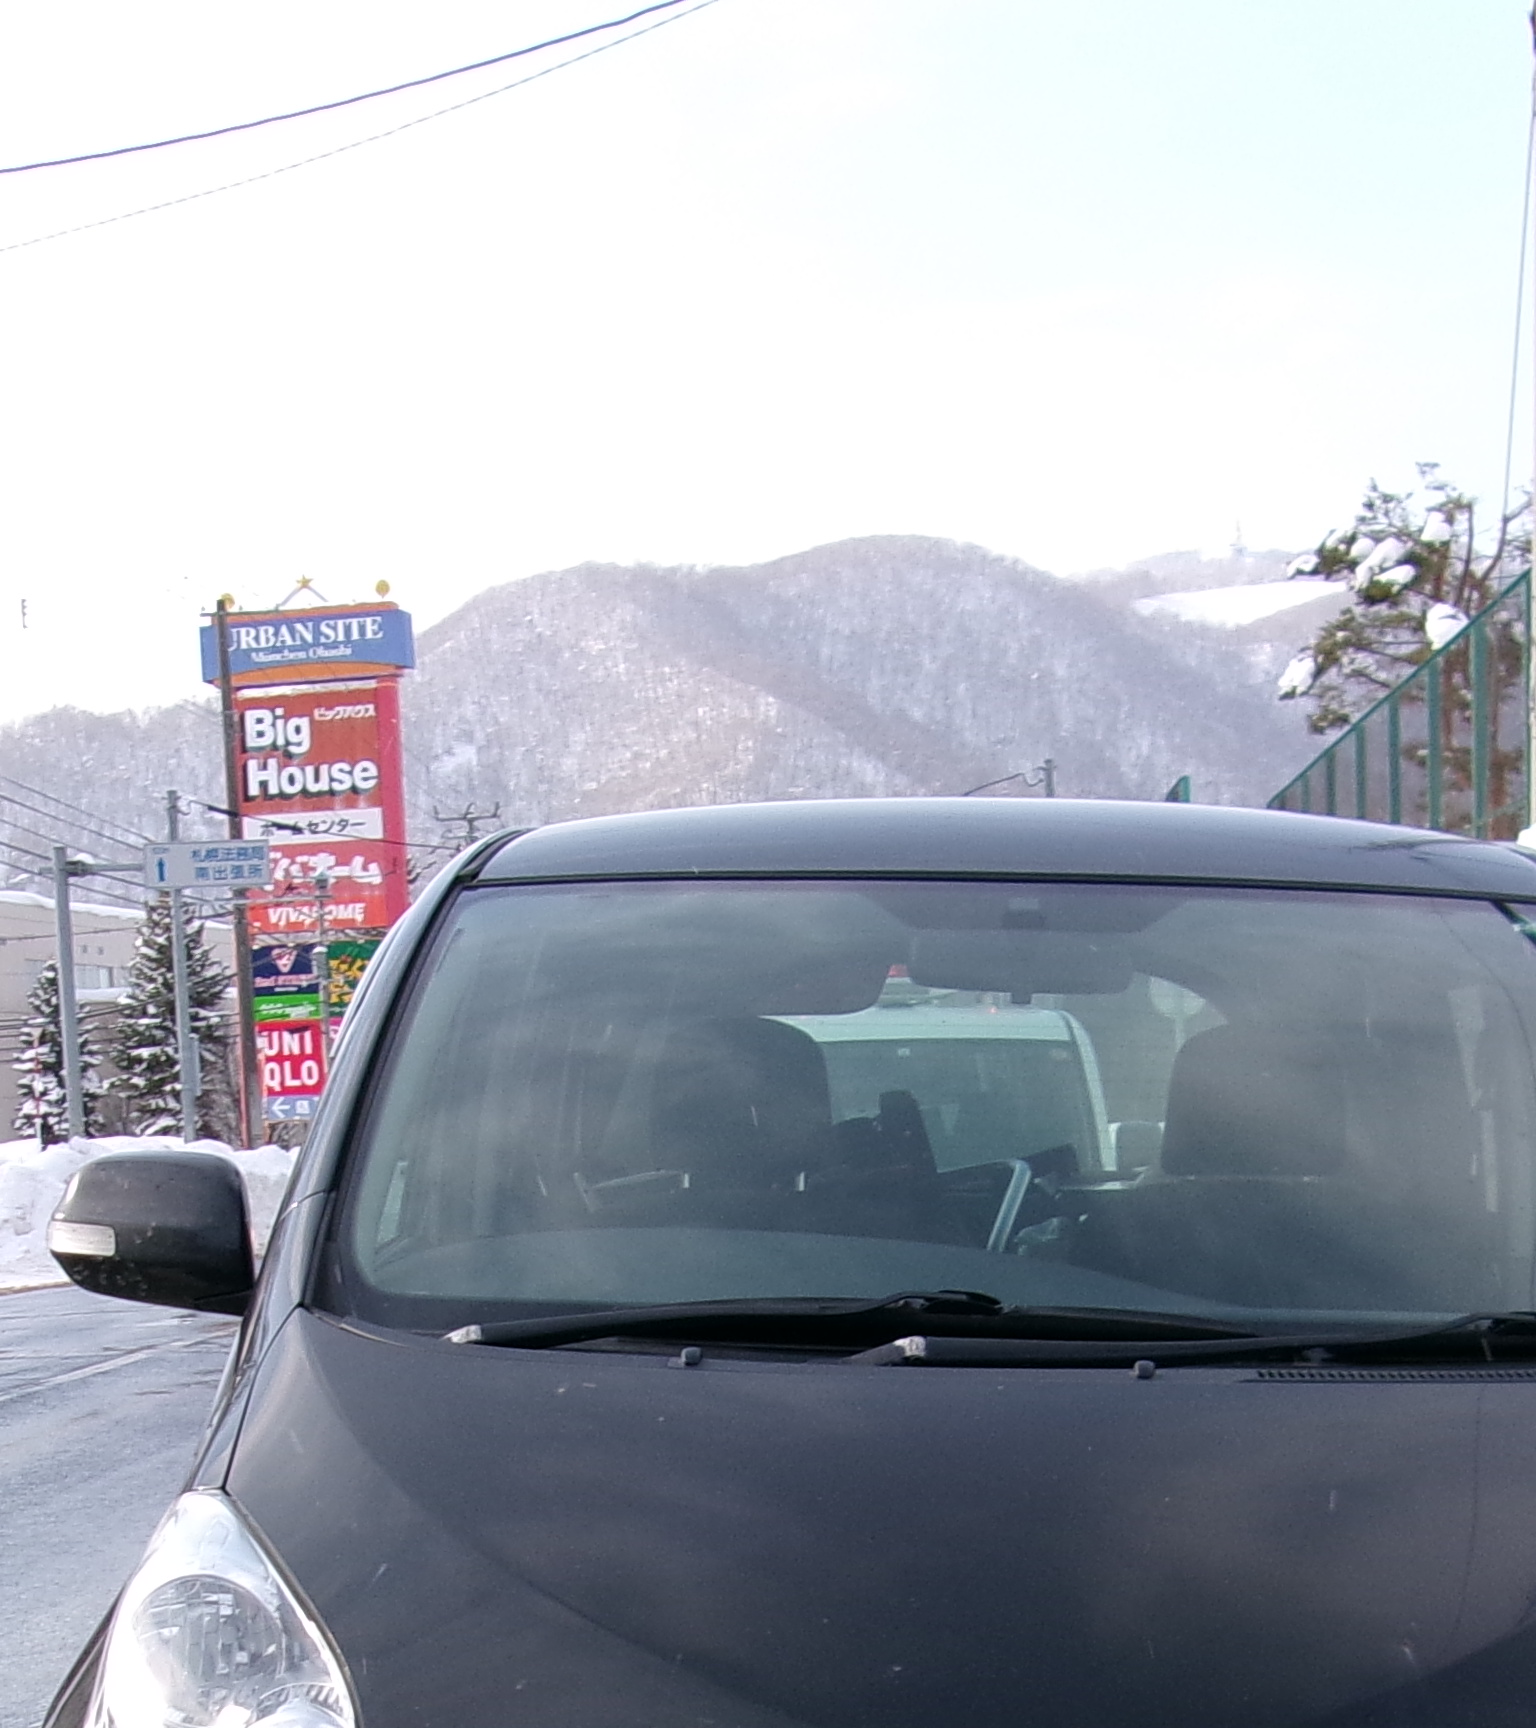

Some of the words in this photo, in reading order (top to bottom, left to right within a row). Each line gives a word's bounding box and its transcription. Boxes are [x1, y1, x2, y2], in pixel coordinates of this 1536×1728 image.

[319, 616, 384, 643] SITE
[244, 707, 311, 755] Big
[246, 758, 379, 797] House
[260, 817, 367, 837] ホセンター
[261, 1030, 313, 1057] UNI
[264, 1060, 320, 1091] QLO
